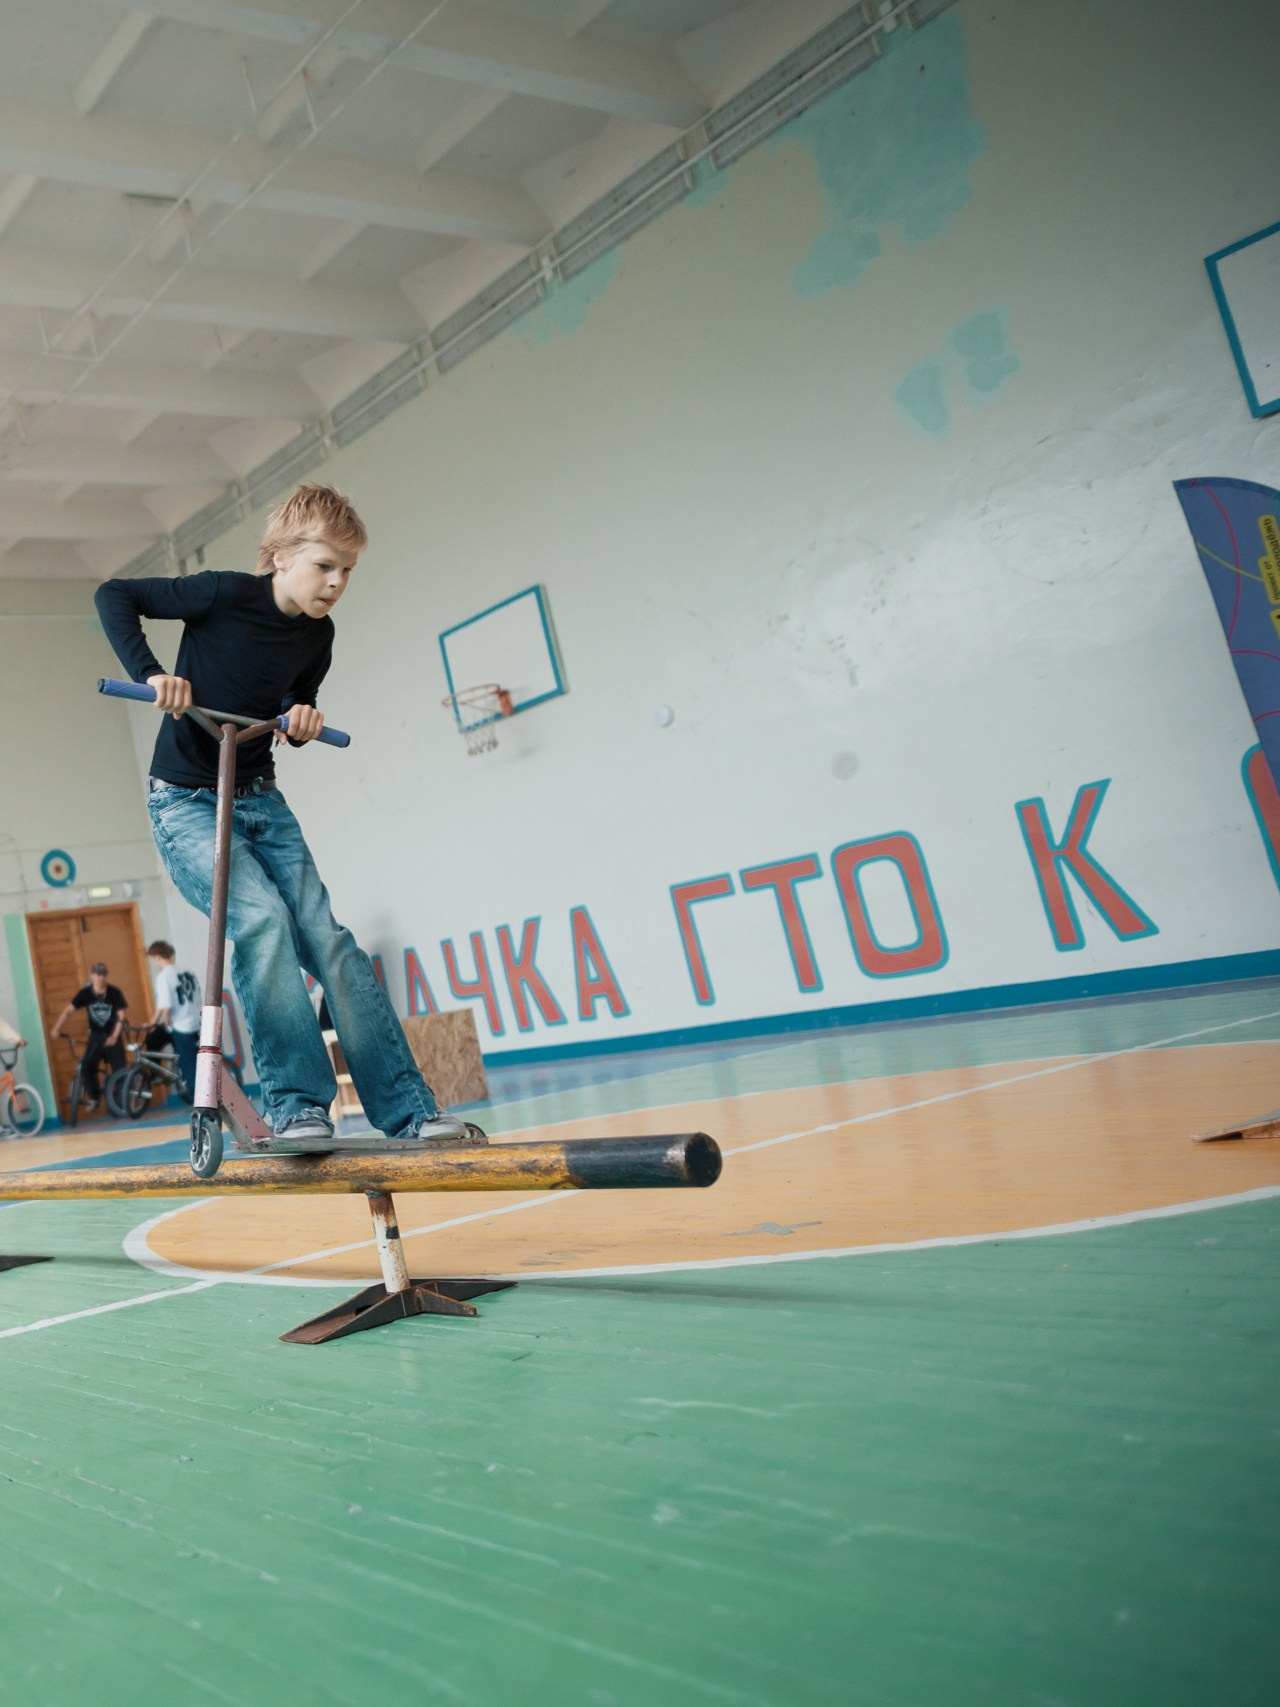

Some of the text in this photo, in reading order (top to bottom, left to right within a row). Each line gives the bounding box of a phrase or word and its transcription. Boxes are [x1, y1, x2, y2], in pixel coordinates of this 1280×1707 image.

[306, 905, 633, 1038] АЧКА
[669, 830, 950, 1006] ГТО
[1015, 777, 1161, 953] К
